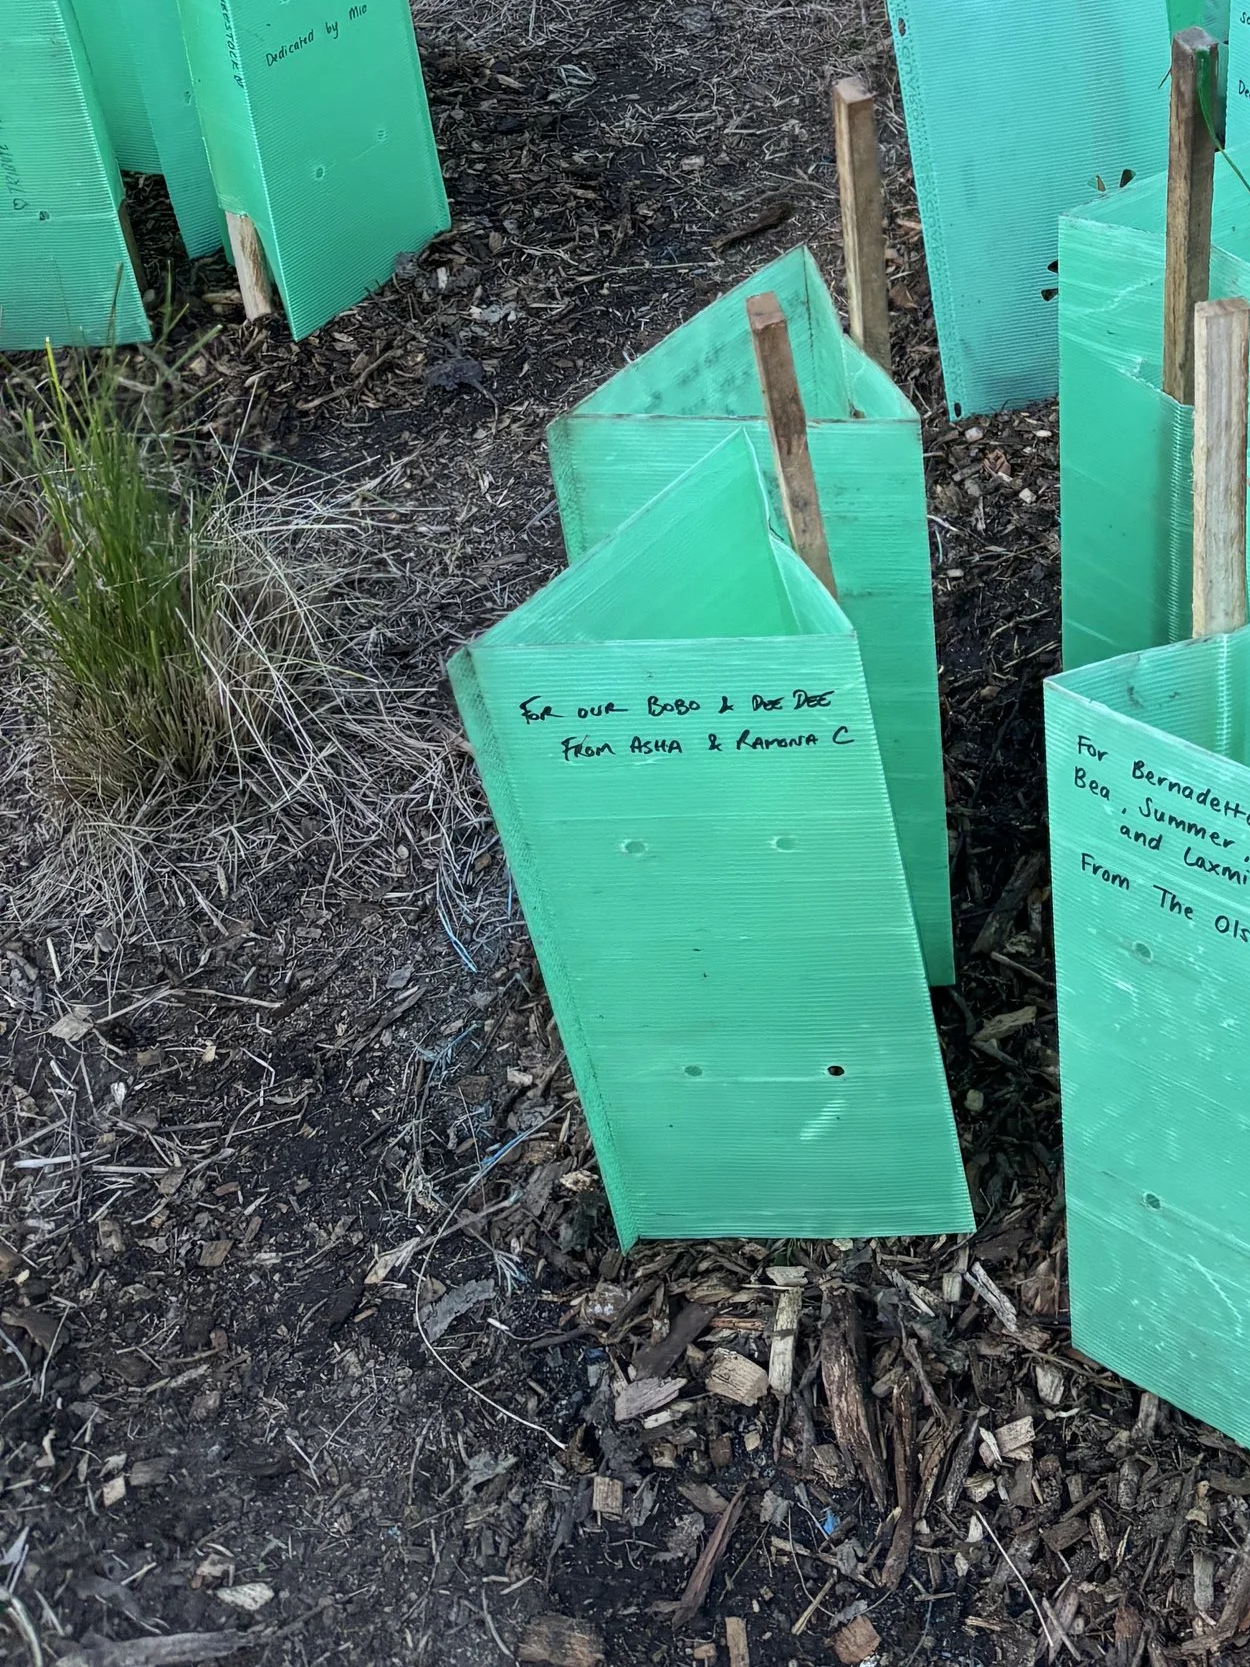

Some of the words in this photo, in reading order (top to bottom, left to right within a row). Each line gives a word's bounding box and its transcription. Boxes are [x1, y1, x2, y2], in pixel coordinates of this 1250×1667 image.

[266, 29, 314, 67] Dedicated
[325, 22, 339, 39] by
[718, 695, 734, 714] &
[752, 695, 784, 711] DEE
[793, 689, 834, 710] DEE
[561, 735, 615, 762] FROM
[630, 735, 682, 754] ASHA
[708, 735, 722, 751] &
[736, 728, 818, 750] RAMONA
[832, 726, 855, 745] C
[1077, 734, 1109, 762] For
[1120, 824, 1163, 851] and
[1183, 846, 1250, 886] Laxmi
[1080, 852, 1130, 891] From
[1153, 884, 1194, 921] The
